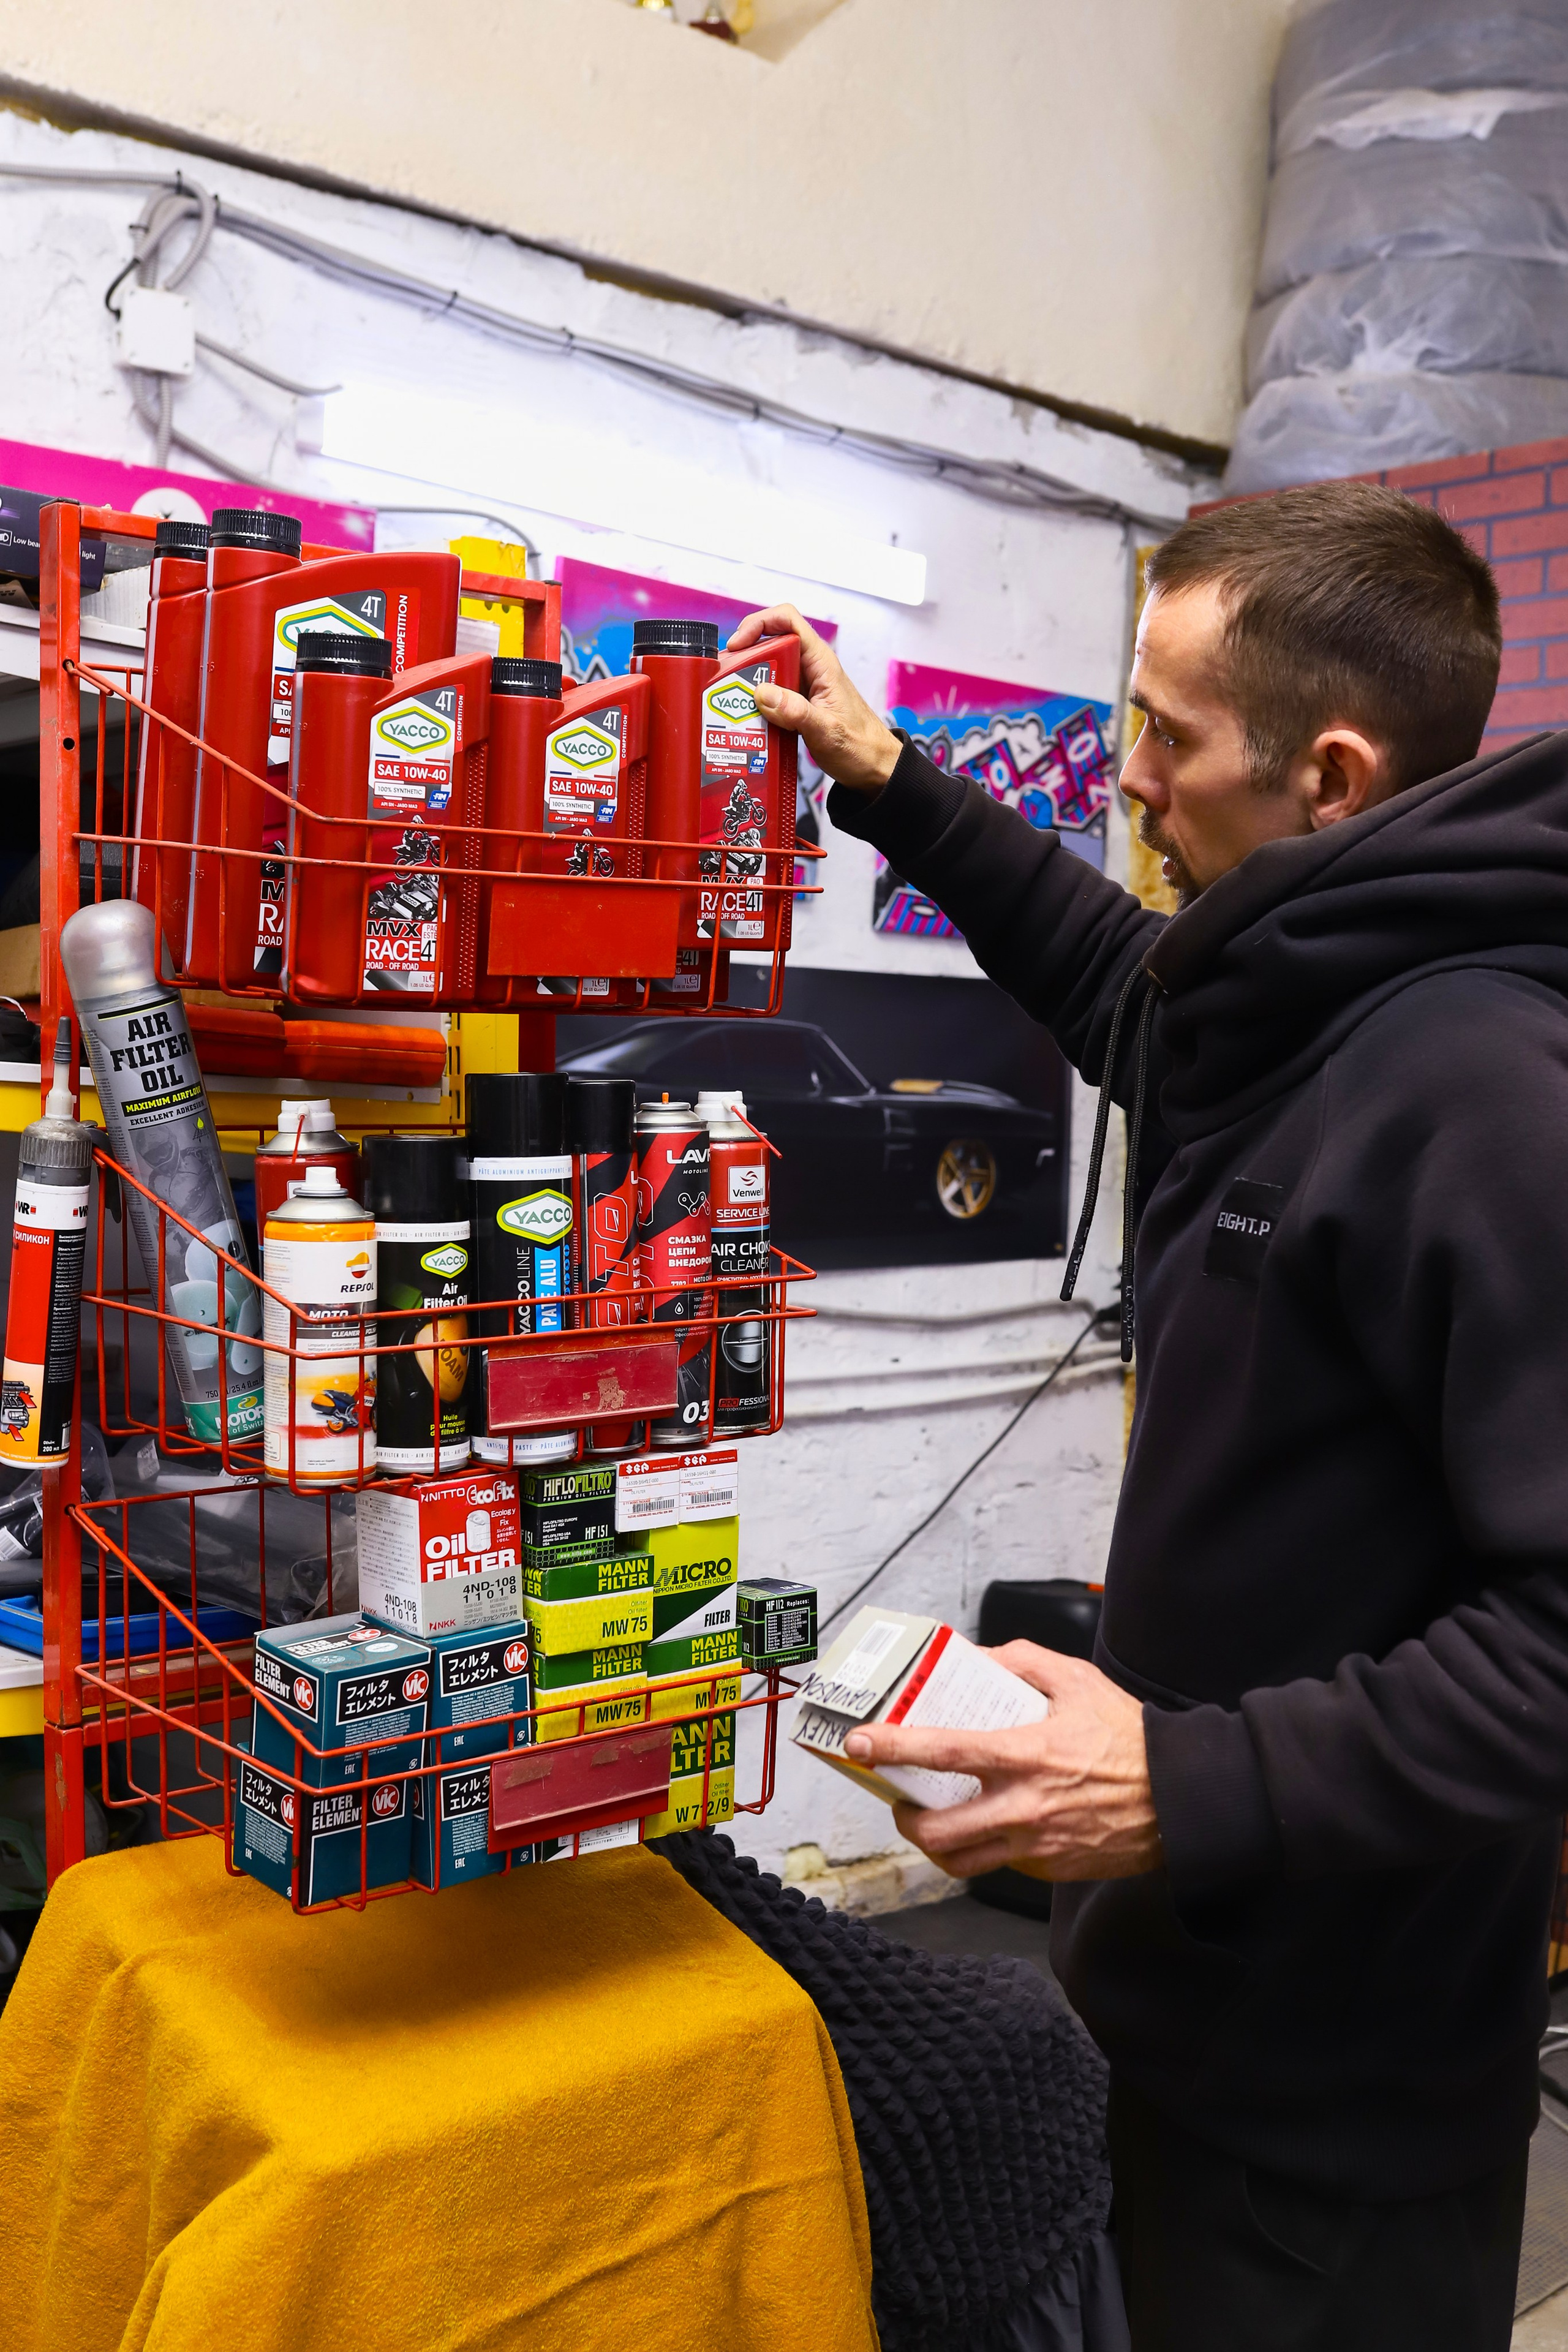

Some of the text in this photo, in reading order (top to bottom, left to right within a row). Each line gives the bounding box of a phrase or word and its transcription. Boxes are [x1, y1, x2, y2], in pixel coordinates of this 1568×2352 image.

[81, 551, 96, 560] light
[361, 595, 382, 618] 4T
[396, 595, 408, 673] COMPETITION
[753, 667, 769, 684] 4T
[435, 690, 454, 711] 4T
[717, 697, 756, 709] YACCO
[389, 723, 440, 738] YACCO
[603, 711, 619, 730] 4T
[562, 742, 606, 756] YACCO
[708, 734, 763, 748] SAE 10W-40
[377, 764, 447, 780] SAE 10W-40
[552, 781, 613, 796] SAE 10W-40
[402, 894, 417, 907] YACCO
[366, 921, 421, 937] MVX
[258, 935, 282, 946] ROAD
[366, 940, 421, 960] RACE
[402, 962, 419, 971] ROAD
[128, 1012, 172, 1042] AIR
[110, 1031, 192, 1072] FILTER
[141, 1065, 185, 1093] OIL
[126, 1085, 201, 1112] MAXIMUM AIRFLOW
[130, 1100, 205, 1126] EXCELLENT ADHESION
[733, 1186, 764, 1198] Venwell
[513, 1207, 571, 1224] YACCO
[716, 1206, 770, 1218] SERVICE LINE
[1216, 1212, 1271, 1236] EIGHT.P
[15, 1231, 50, 1245] СИЛИКОН
[668, 1235, 706, 1245] СМАЗКА
[711, 1240, 771, 1256] AIR CHOK
[431, 1255, 464, 1267] YACCO
[668, 1247, 696, 1257] ЦЕПИ
[540, 1259, 557, 1285] ALU
[720, 1257, 769, 1272] CLEANER
[341, 1282, 374, 1293] REPSOL
[442, 1283, 458, 1295] Air
[424, 1295, 467, 1309] Filter Oil
[683, 1400, 709, 1424] 03
[429, 1480, 515, 1506] NITTO EcoFix
[543, 1472, 612, 1498] HIFLOFILTRO
[543, 1494, 571, 1502] PREMIUM
[491, 1508, 516, 1518] Ecology
[425, 1533, 466, 1559] Oil
[427, 1548, 516, 1583] FILTER
[598, 1558, 649, 1578] MANN
[653, 1557, 732, 1589] MICRO
[462, 1575, 516, 1594] 4ND-108
[598, 1572, 649, 1592] FILTER
[653, 1585, 674, 1594] NIPPON
[675, 1583, 693, 1591] MICRO
[384, 1593, 417, 1613] 4ND-108
[786, 1599, 809, 1607] Replaces:
[437, 1619, 456, 1629] NKK
[601, 1615, 648, 1638] MW 75
[704, 1610, 731, 1627] FILTER
[285, 1640, 332, 1653] FILTER
[691, 1631, 738, 1652] MANN
[448, 1651, 490, 1672] フィルタ
[592, 1643, 643, 1664] MANN
[691, 1645, 737, 1665] FILTER
[254, 1653, 281, 1679] FILTER
[448, 1665, 499, 1687] エレメント
[592, 1659, 643, 1679] FILTER
[254, 1668, 291, 1700] ELEMENT
[346, 1679, 390, 1700] フィルタ
[726, 1676, 736, 1685] filter
[345, 1693, 396, 1715] エレメント
[720, 1686, 737, 1704] 75
[596, 1700, 641, 1724] MW 75
[796, 1711, 848, 1749] ARLEY
[246, 1771, 273, 1796] フィルタ
[245, 1786, 277, 1815] エレメント
[312, 1794, 353, 1816] FILTER
[692, 1797, 729, 1820] 72/9
